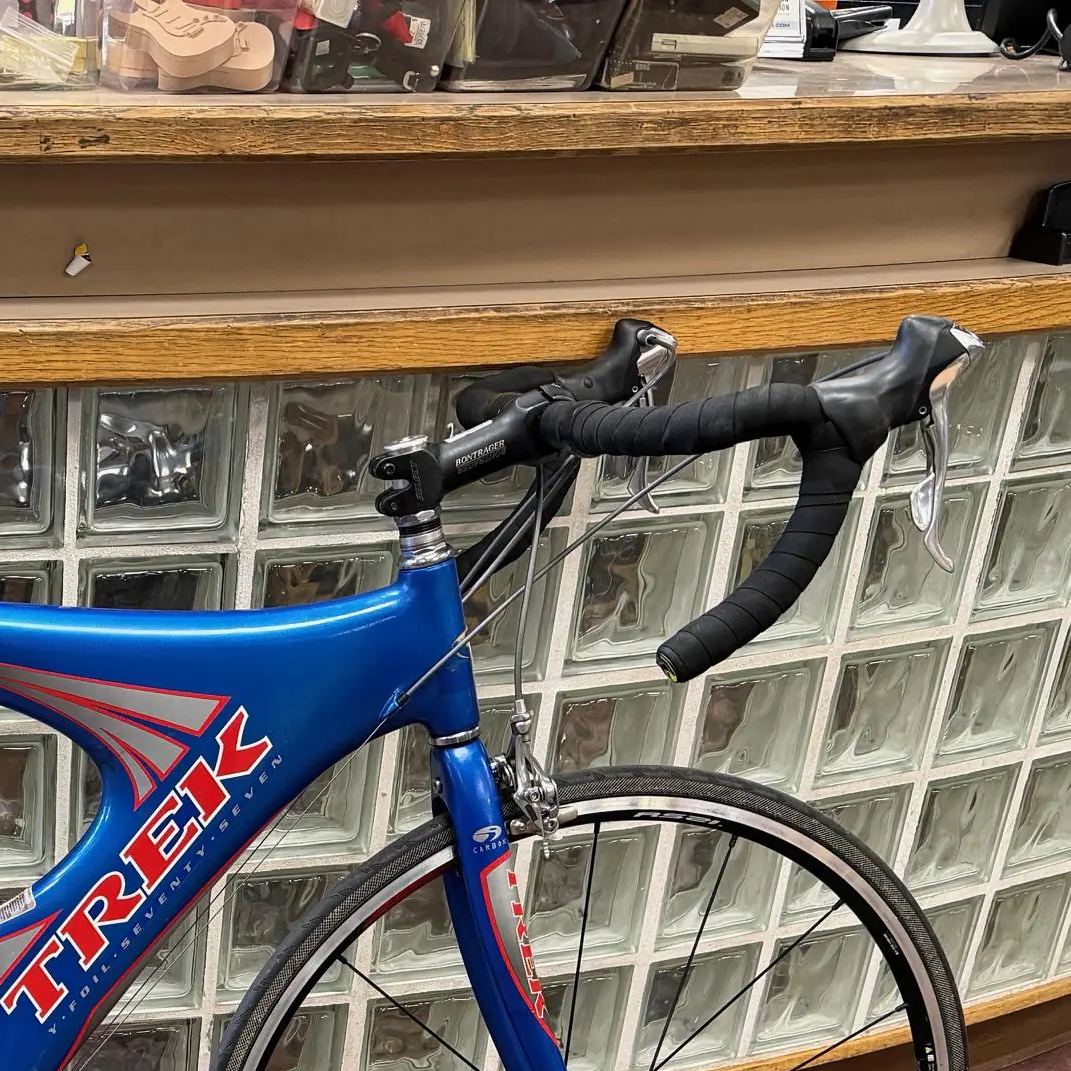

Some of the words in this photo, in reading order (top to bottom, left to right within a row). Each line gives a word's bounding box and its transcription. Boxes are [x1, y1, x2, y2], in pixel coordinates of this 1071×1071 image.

[455, 439, 506, 468] BONTRAGER
[472, 839, 507, 854] CARBON
[0, 705, 274, 1025] TREK
